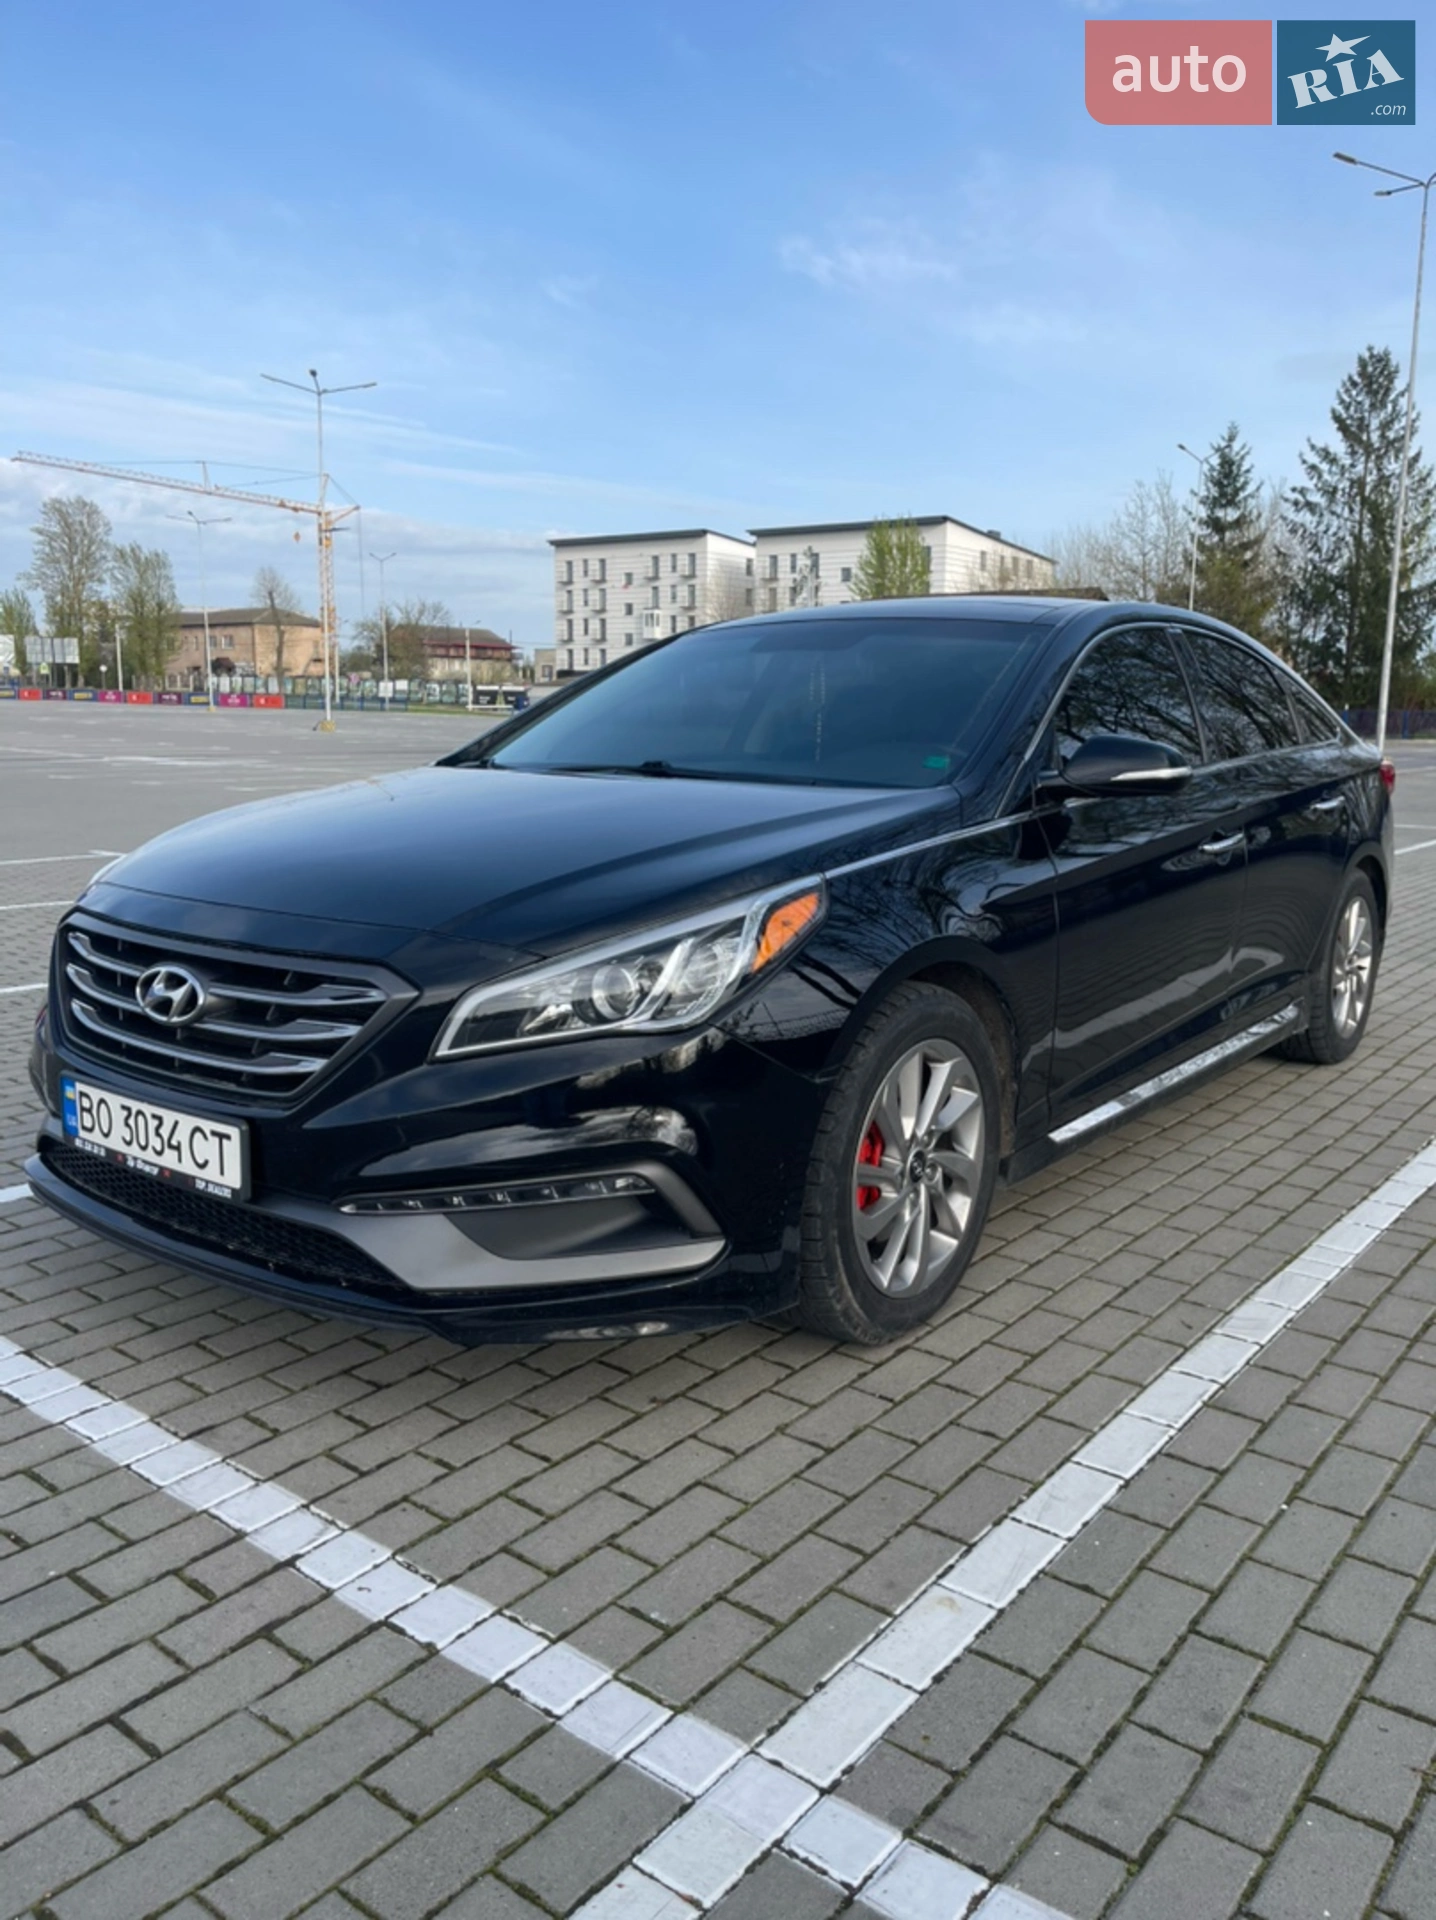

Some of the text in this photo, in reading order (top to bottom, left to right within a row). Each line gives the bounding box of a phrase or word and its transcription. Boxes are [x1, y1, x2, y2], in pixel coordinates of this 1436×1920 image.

[79, 1091, 113, 1139] BO
[120, 1104, 182, 1164] 3034
[189, 1125, 232, 1177] CT
